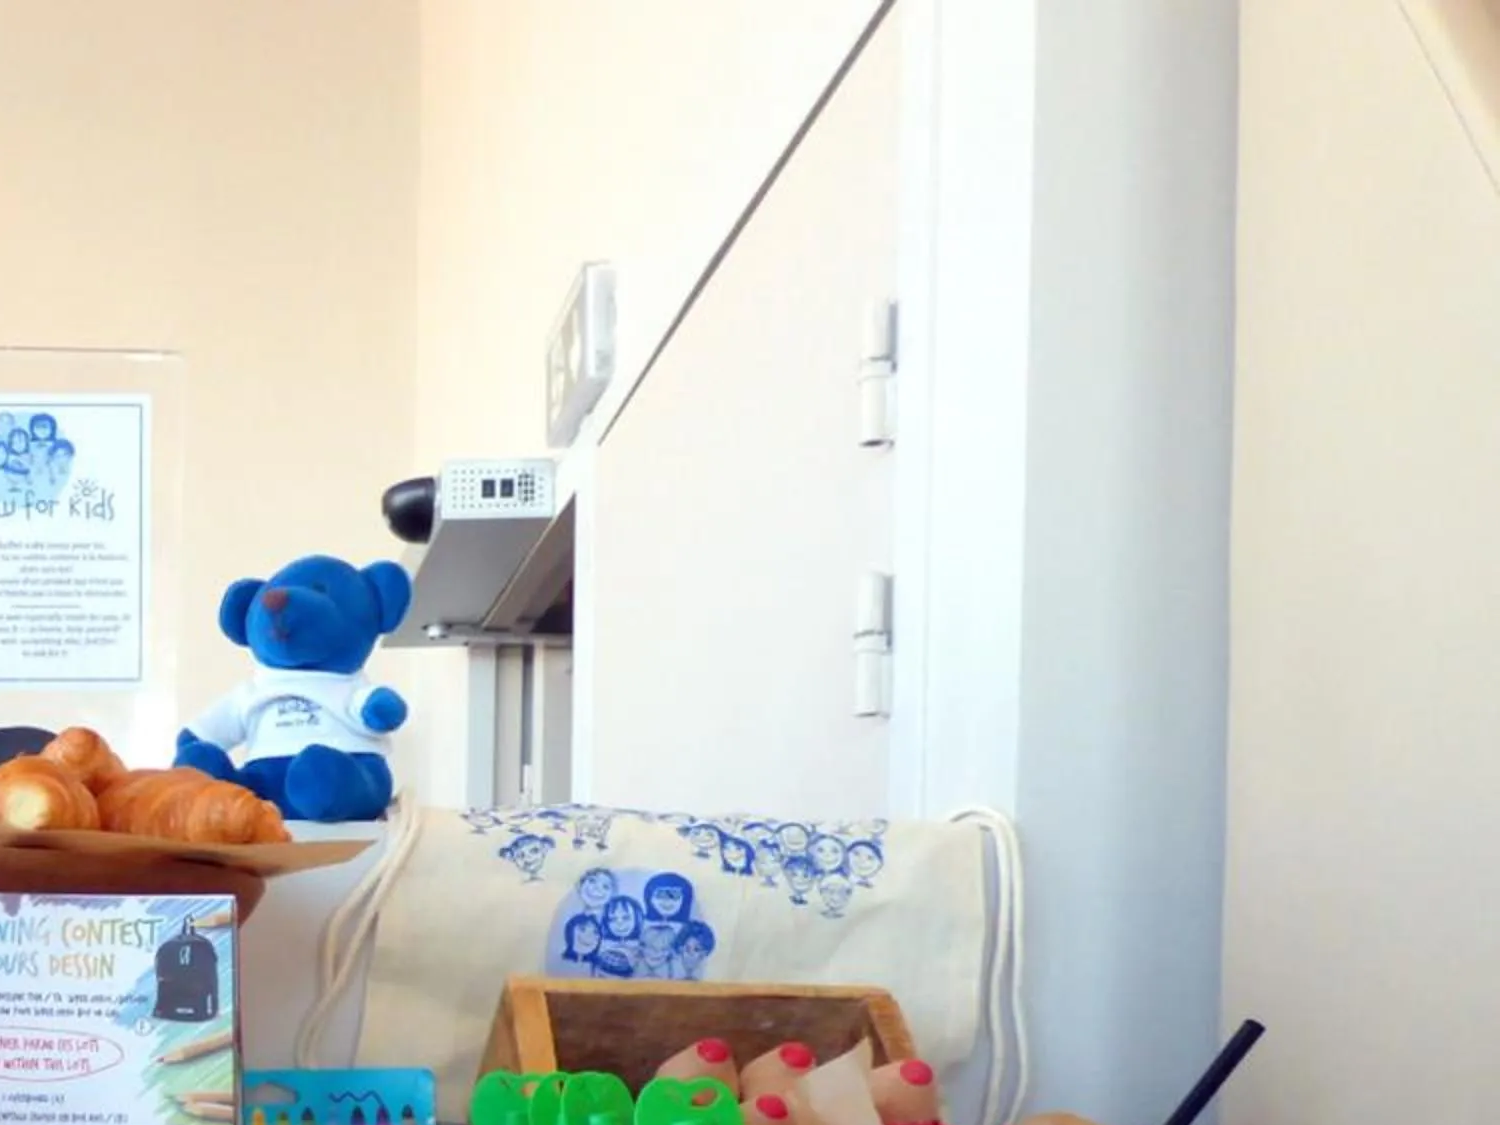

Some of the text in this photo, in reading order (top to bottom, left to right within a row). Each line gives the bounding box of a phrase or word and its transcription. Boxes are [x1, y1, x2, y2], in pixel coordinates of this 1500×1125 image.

[19, 489, 60, 521] for
[61, 917, 164, 952] CONTEST
[49, 953, 116, 979] DESSIN
